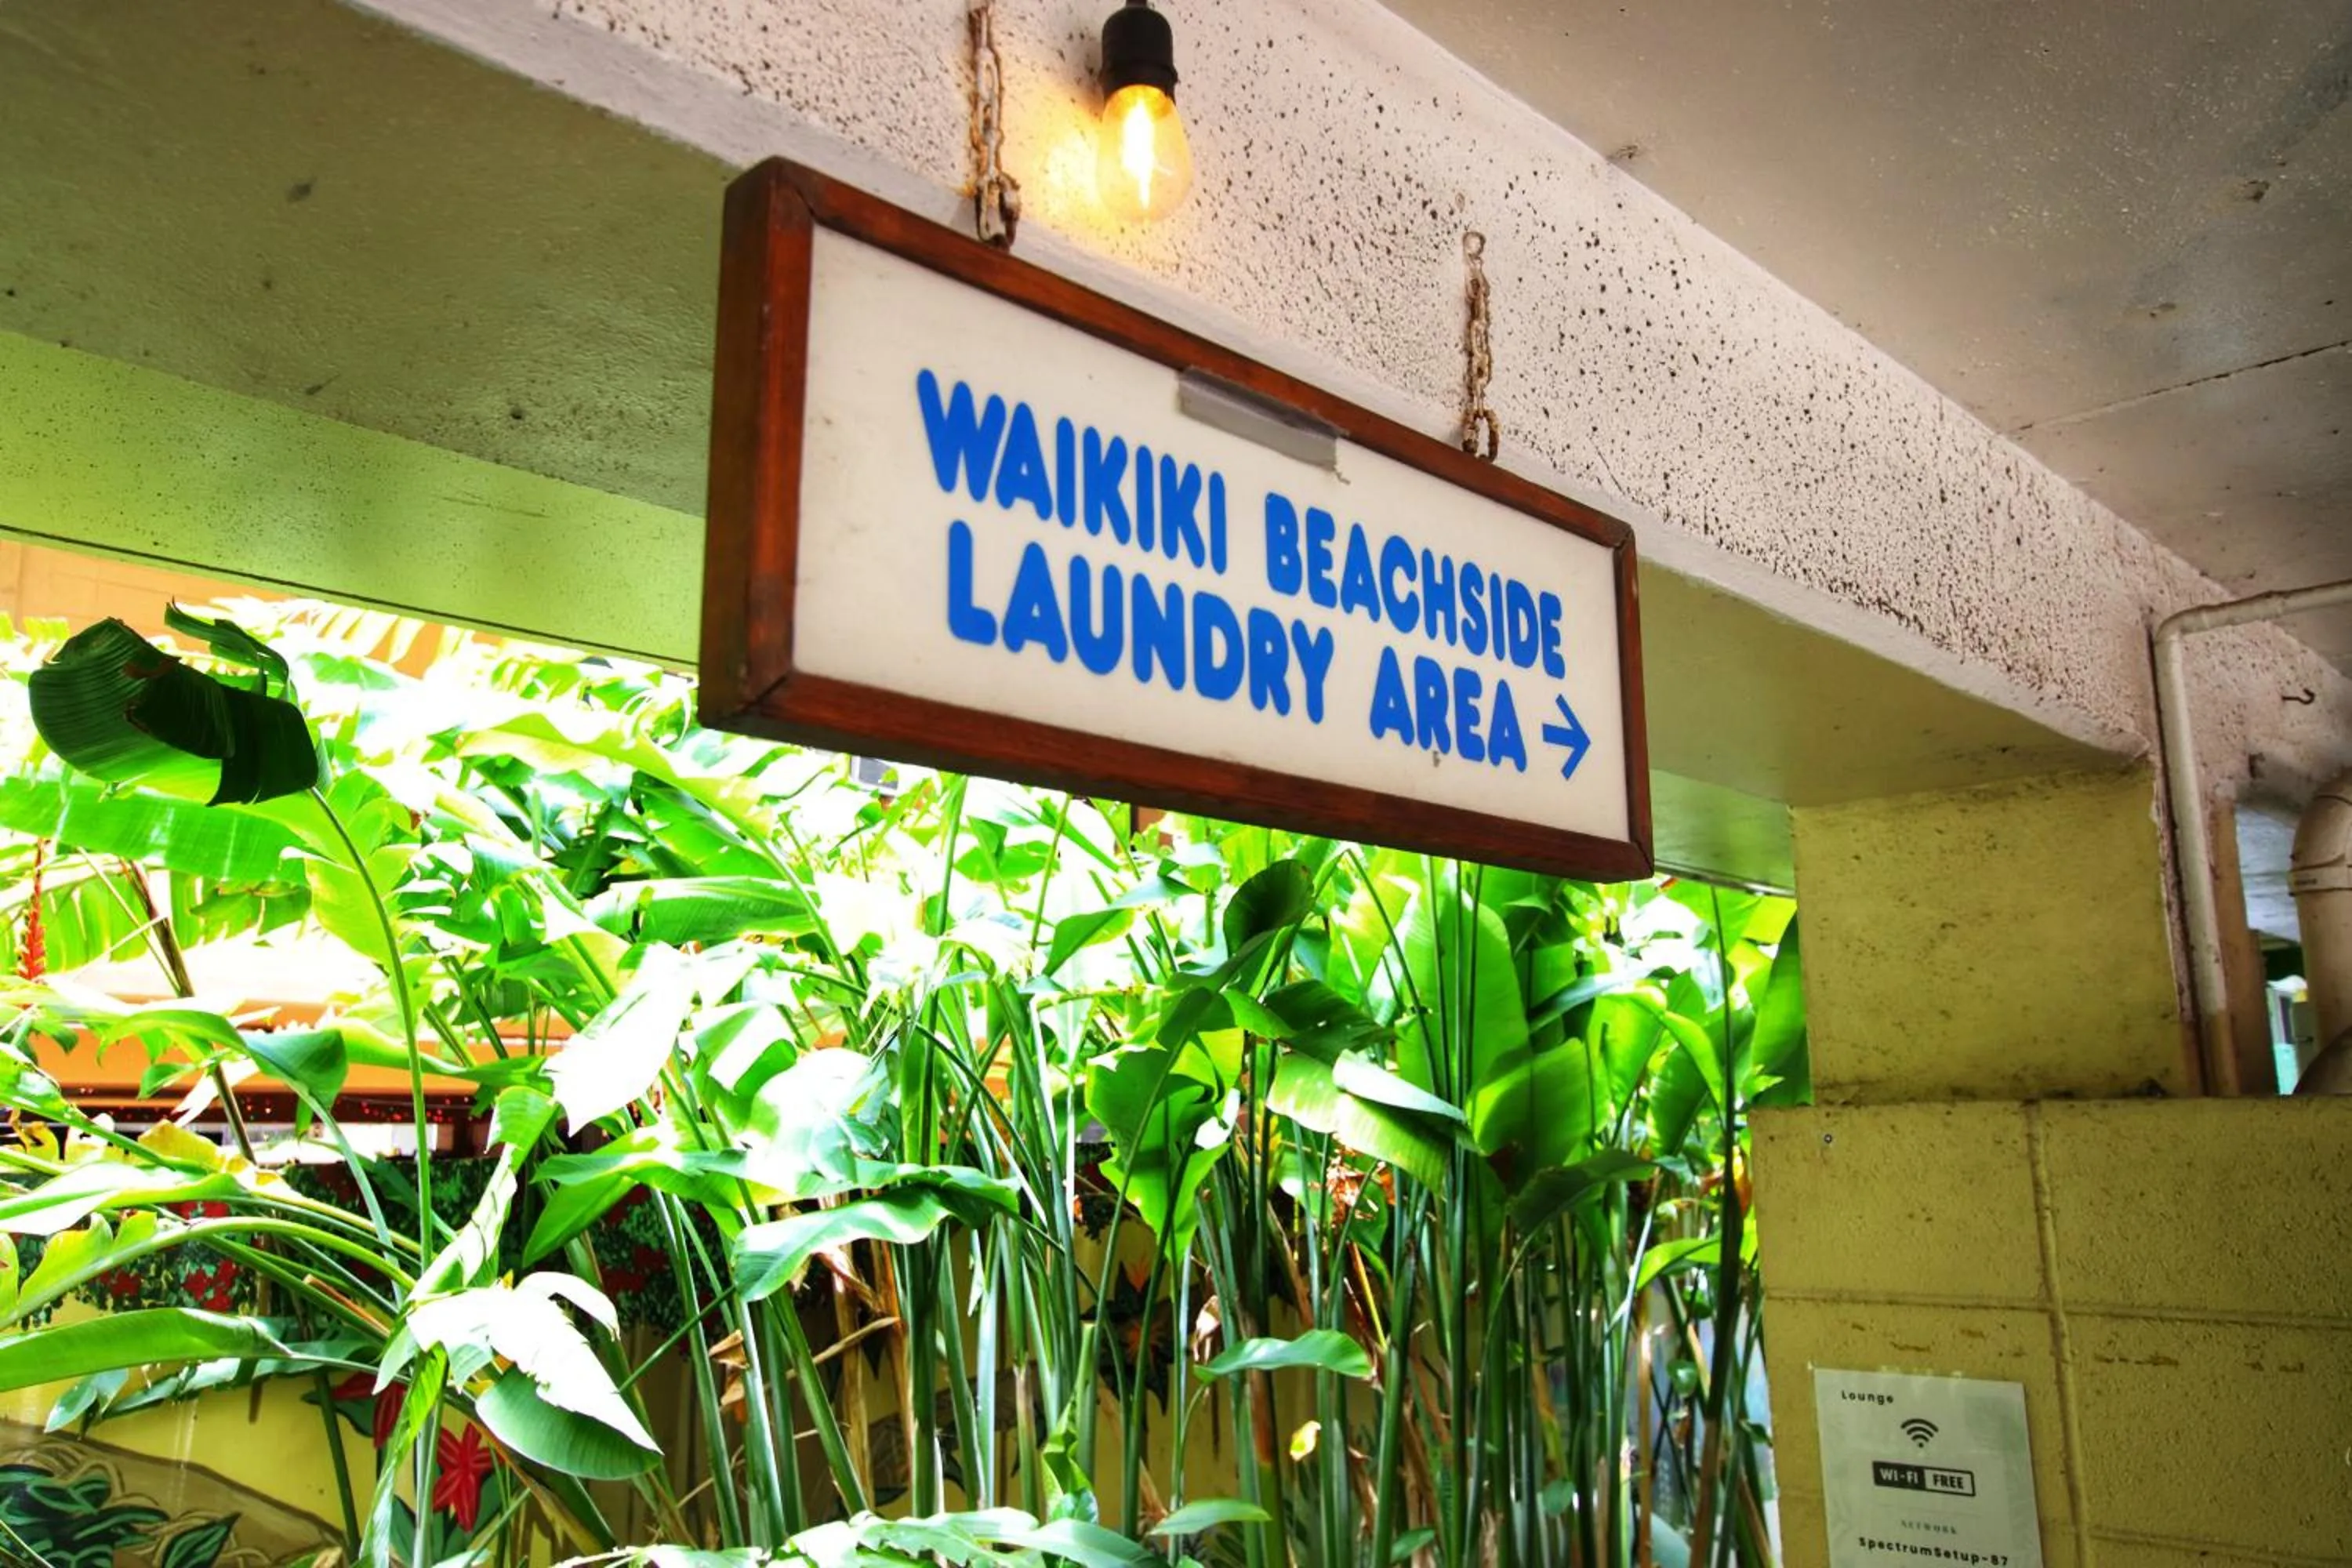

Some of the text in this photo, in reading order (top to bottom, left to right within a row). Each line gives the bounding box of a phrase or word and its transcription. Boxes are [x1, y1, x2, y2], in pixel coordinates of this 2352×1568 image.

[917, 368, 1566, 679] WAIKIKI BEACHSIDE
[948, 520, 1527, 771] LAUNDRY AREA
[1842, 1389, 1894, 1405] Lounge
[1933, 1473, 1964, 1489] FREE
